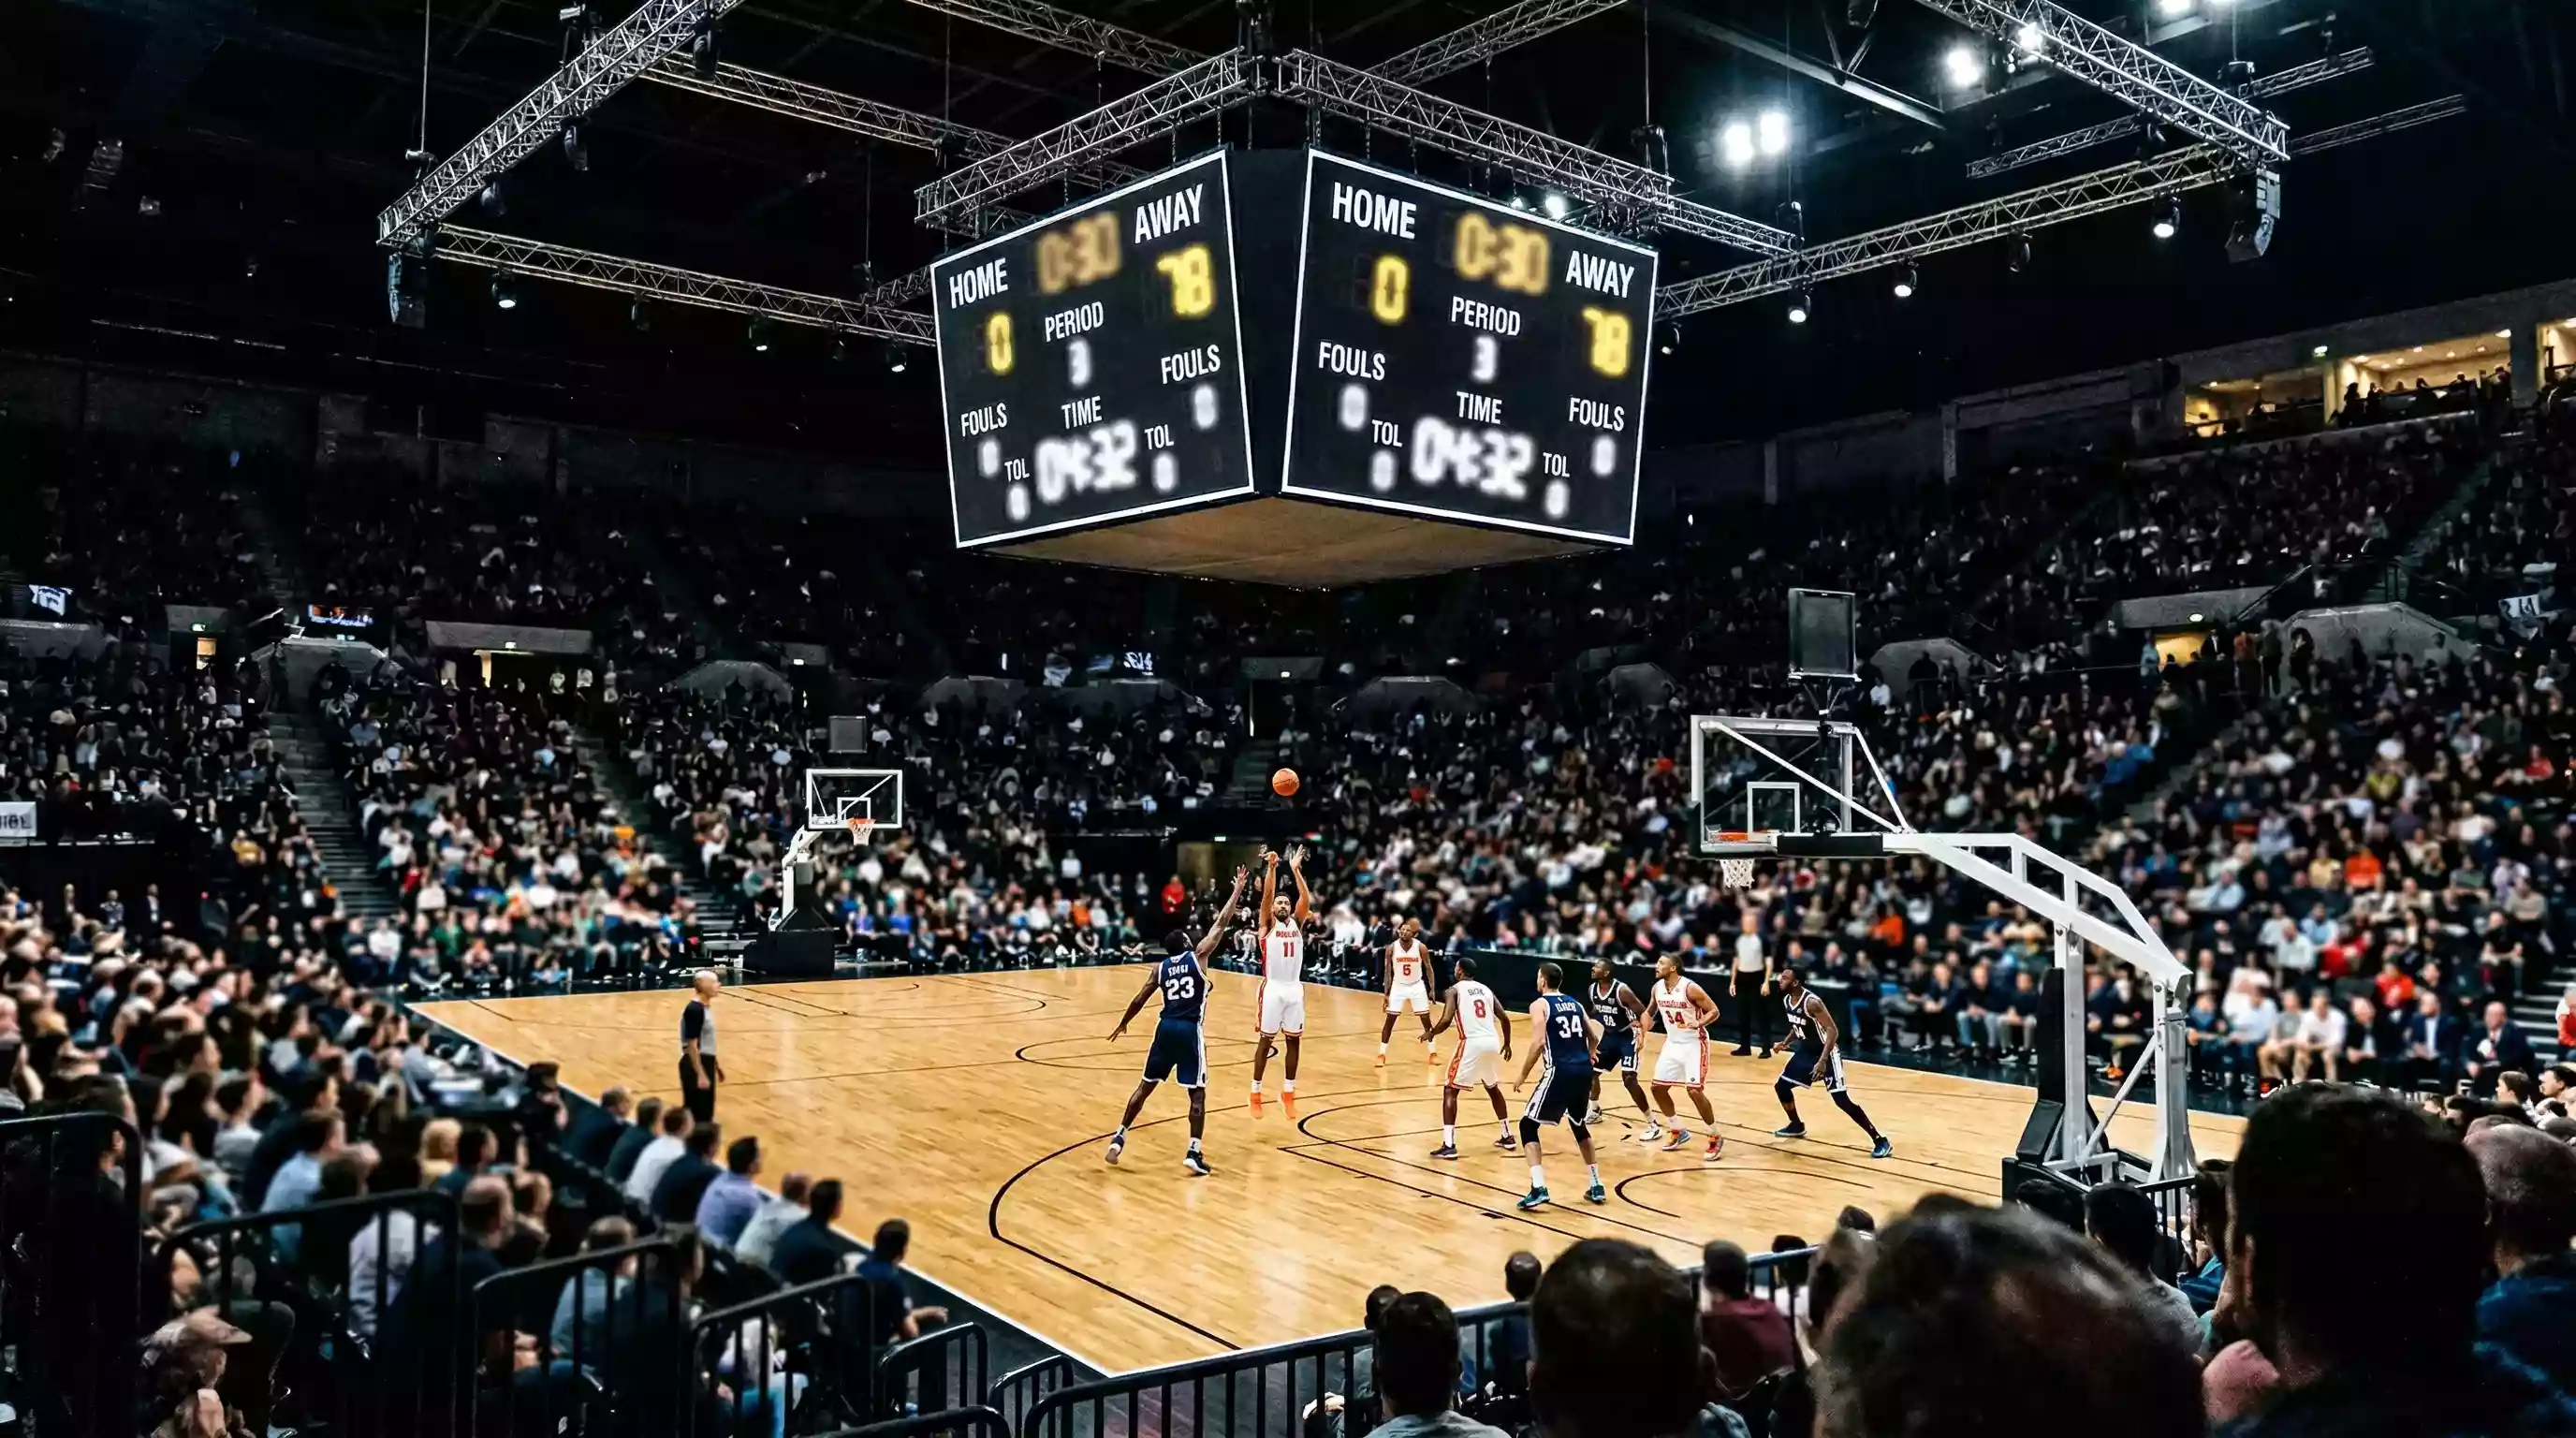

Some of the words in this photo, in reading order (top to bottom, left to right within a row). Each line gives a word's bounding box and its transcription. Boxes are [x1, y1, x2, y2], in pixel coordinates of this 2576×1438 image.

[1134, 183, 1205, 244] AWAY
[1332, 183, 1417, 240] HOME
[949, 257, 1008, 308] HOME
[1157, 244, 1215, 316] 78
[1372, 255, 1409, 323] 0
[1566, 250, 1634, 298] AWAY
[1045, 301, 1104, 342] PERIOD
[1451, 296, 1520, 336] PERIOD
[986, 312, 1014, 374] 0
[1582, 306, 1631, 377] 78
[1160, 345, 1221, 384] FOULS
[1318, 341, 1385, 381] FOULS
[961, 403, 1007, 436] FOULS
[1061, 396, 1103, 429] TIME
[1456, 390, 1502, 424] TIME
[1569, 397, 1625, 432] FOULS
[1144, 424, 1175, 449] TOL
[1371, 419, 1403, 448] TOL
[1004, 459, 1031, 482] TOL
[1544, 452, 1571, 477] TOL
[1283, 942, 1295, 957] 11
[1403, 964, 1412, 976] 5
[1165, 976, 1194, 1000] 23
[1473, 999, 1486, 1019] 8
[1556, 1015, 1583, 1038] 34
